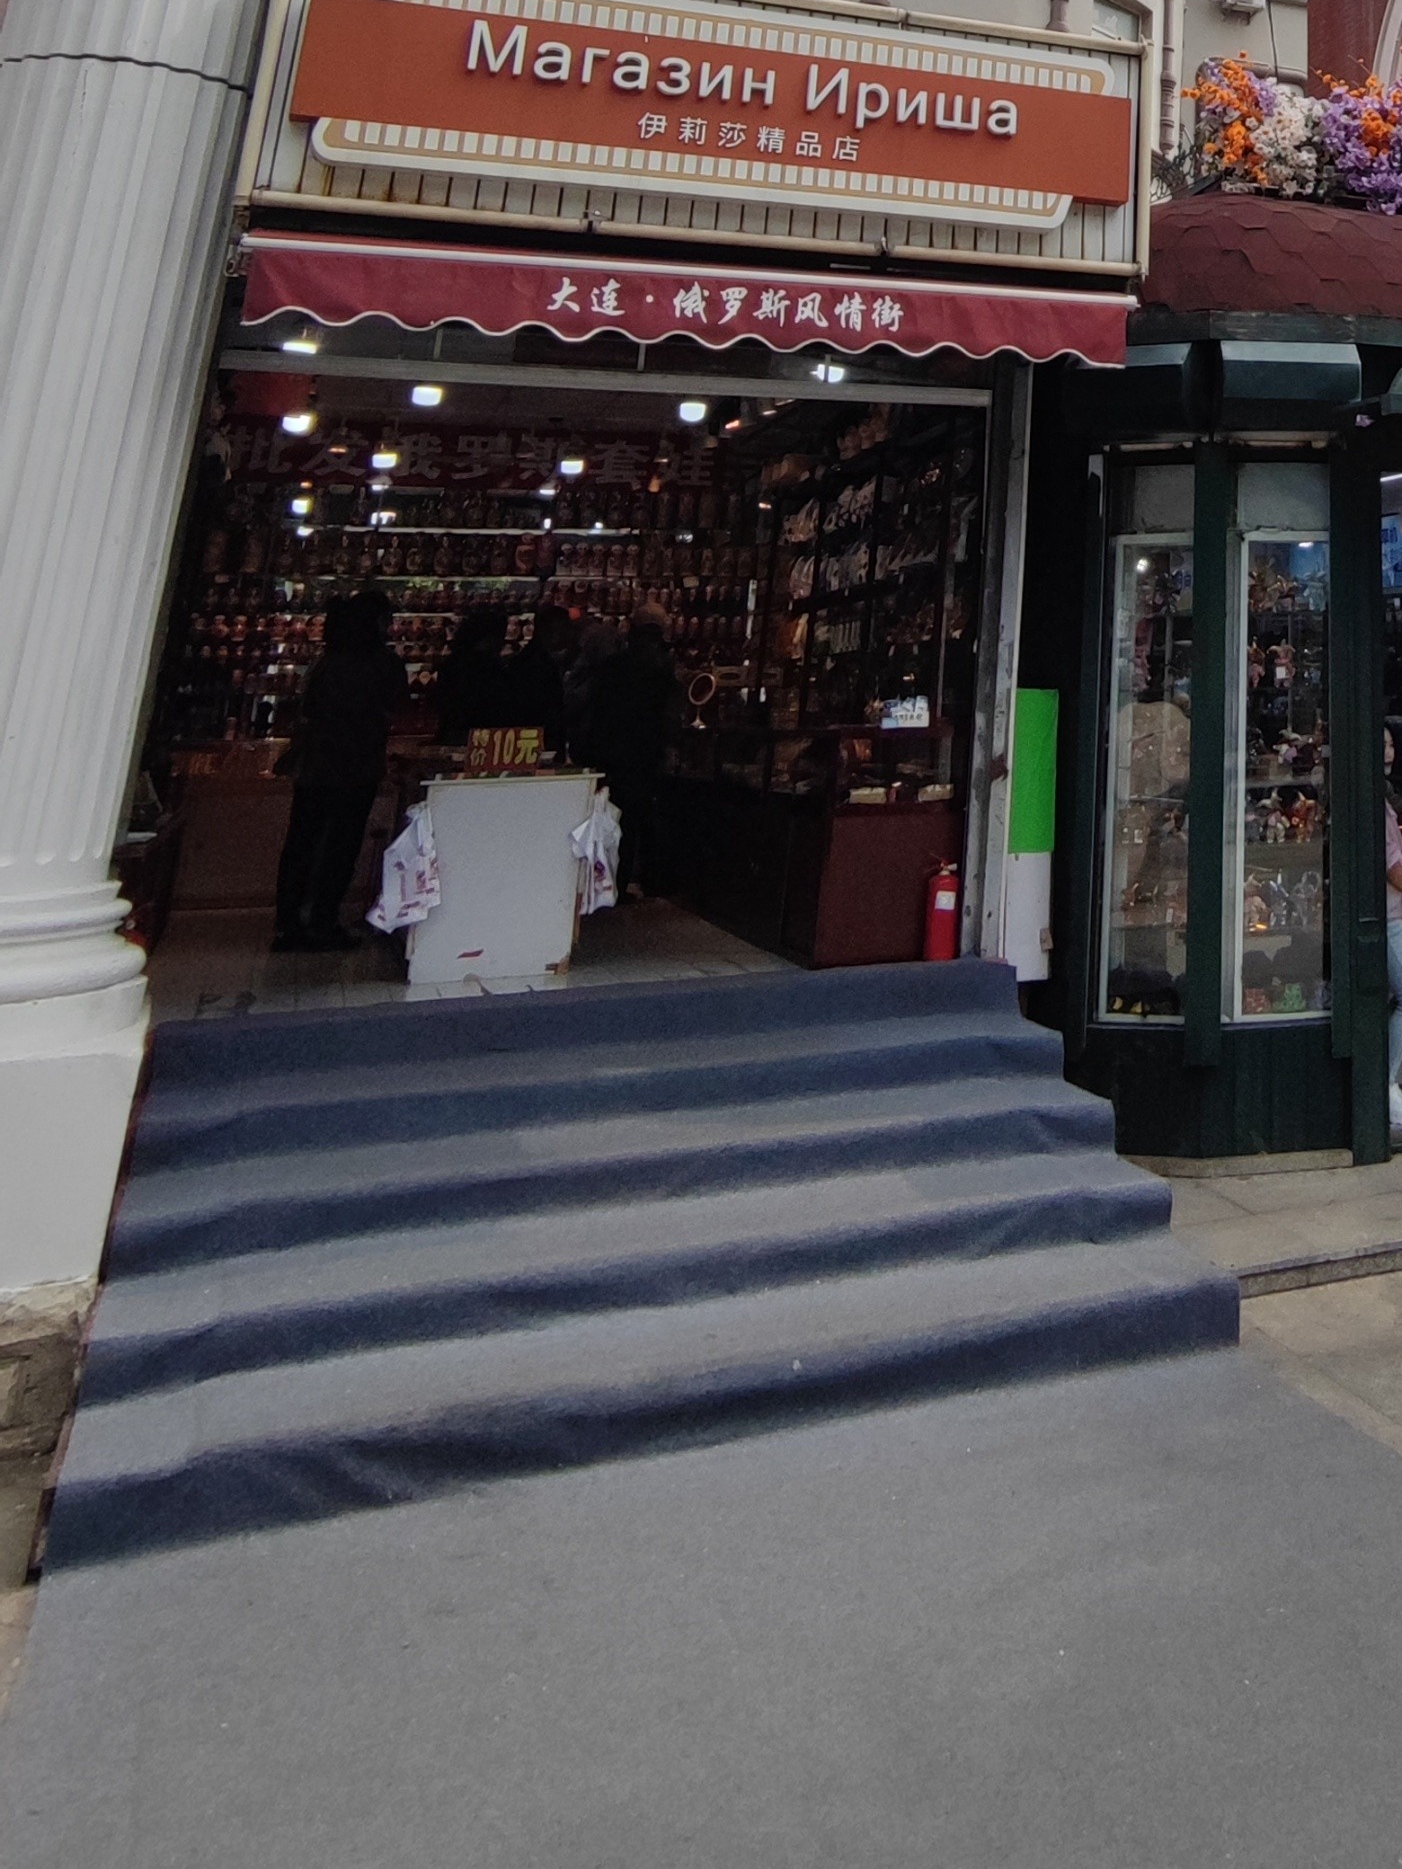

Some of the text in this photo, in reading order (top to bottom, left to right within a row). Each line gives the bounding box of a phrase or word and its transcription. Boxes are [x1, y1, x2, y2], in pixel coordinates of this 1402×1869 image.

[465, 18, 1019, 137] Магазин Ириша
[637, 111, 861, 162] 伊莉莎精品店
[492, 728, 539, 767] 10元
